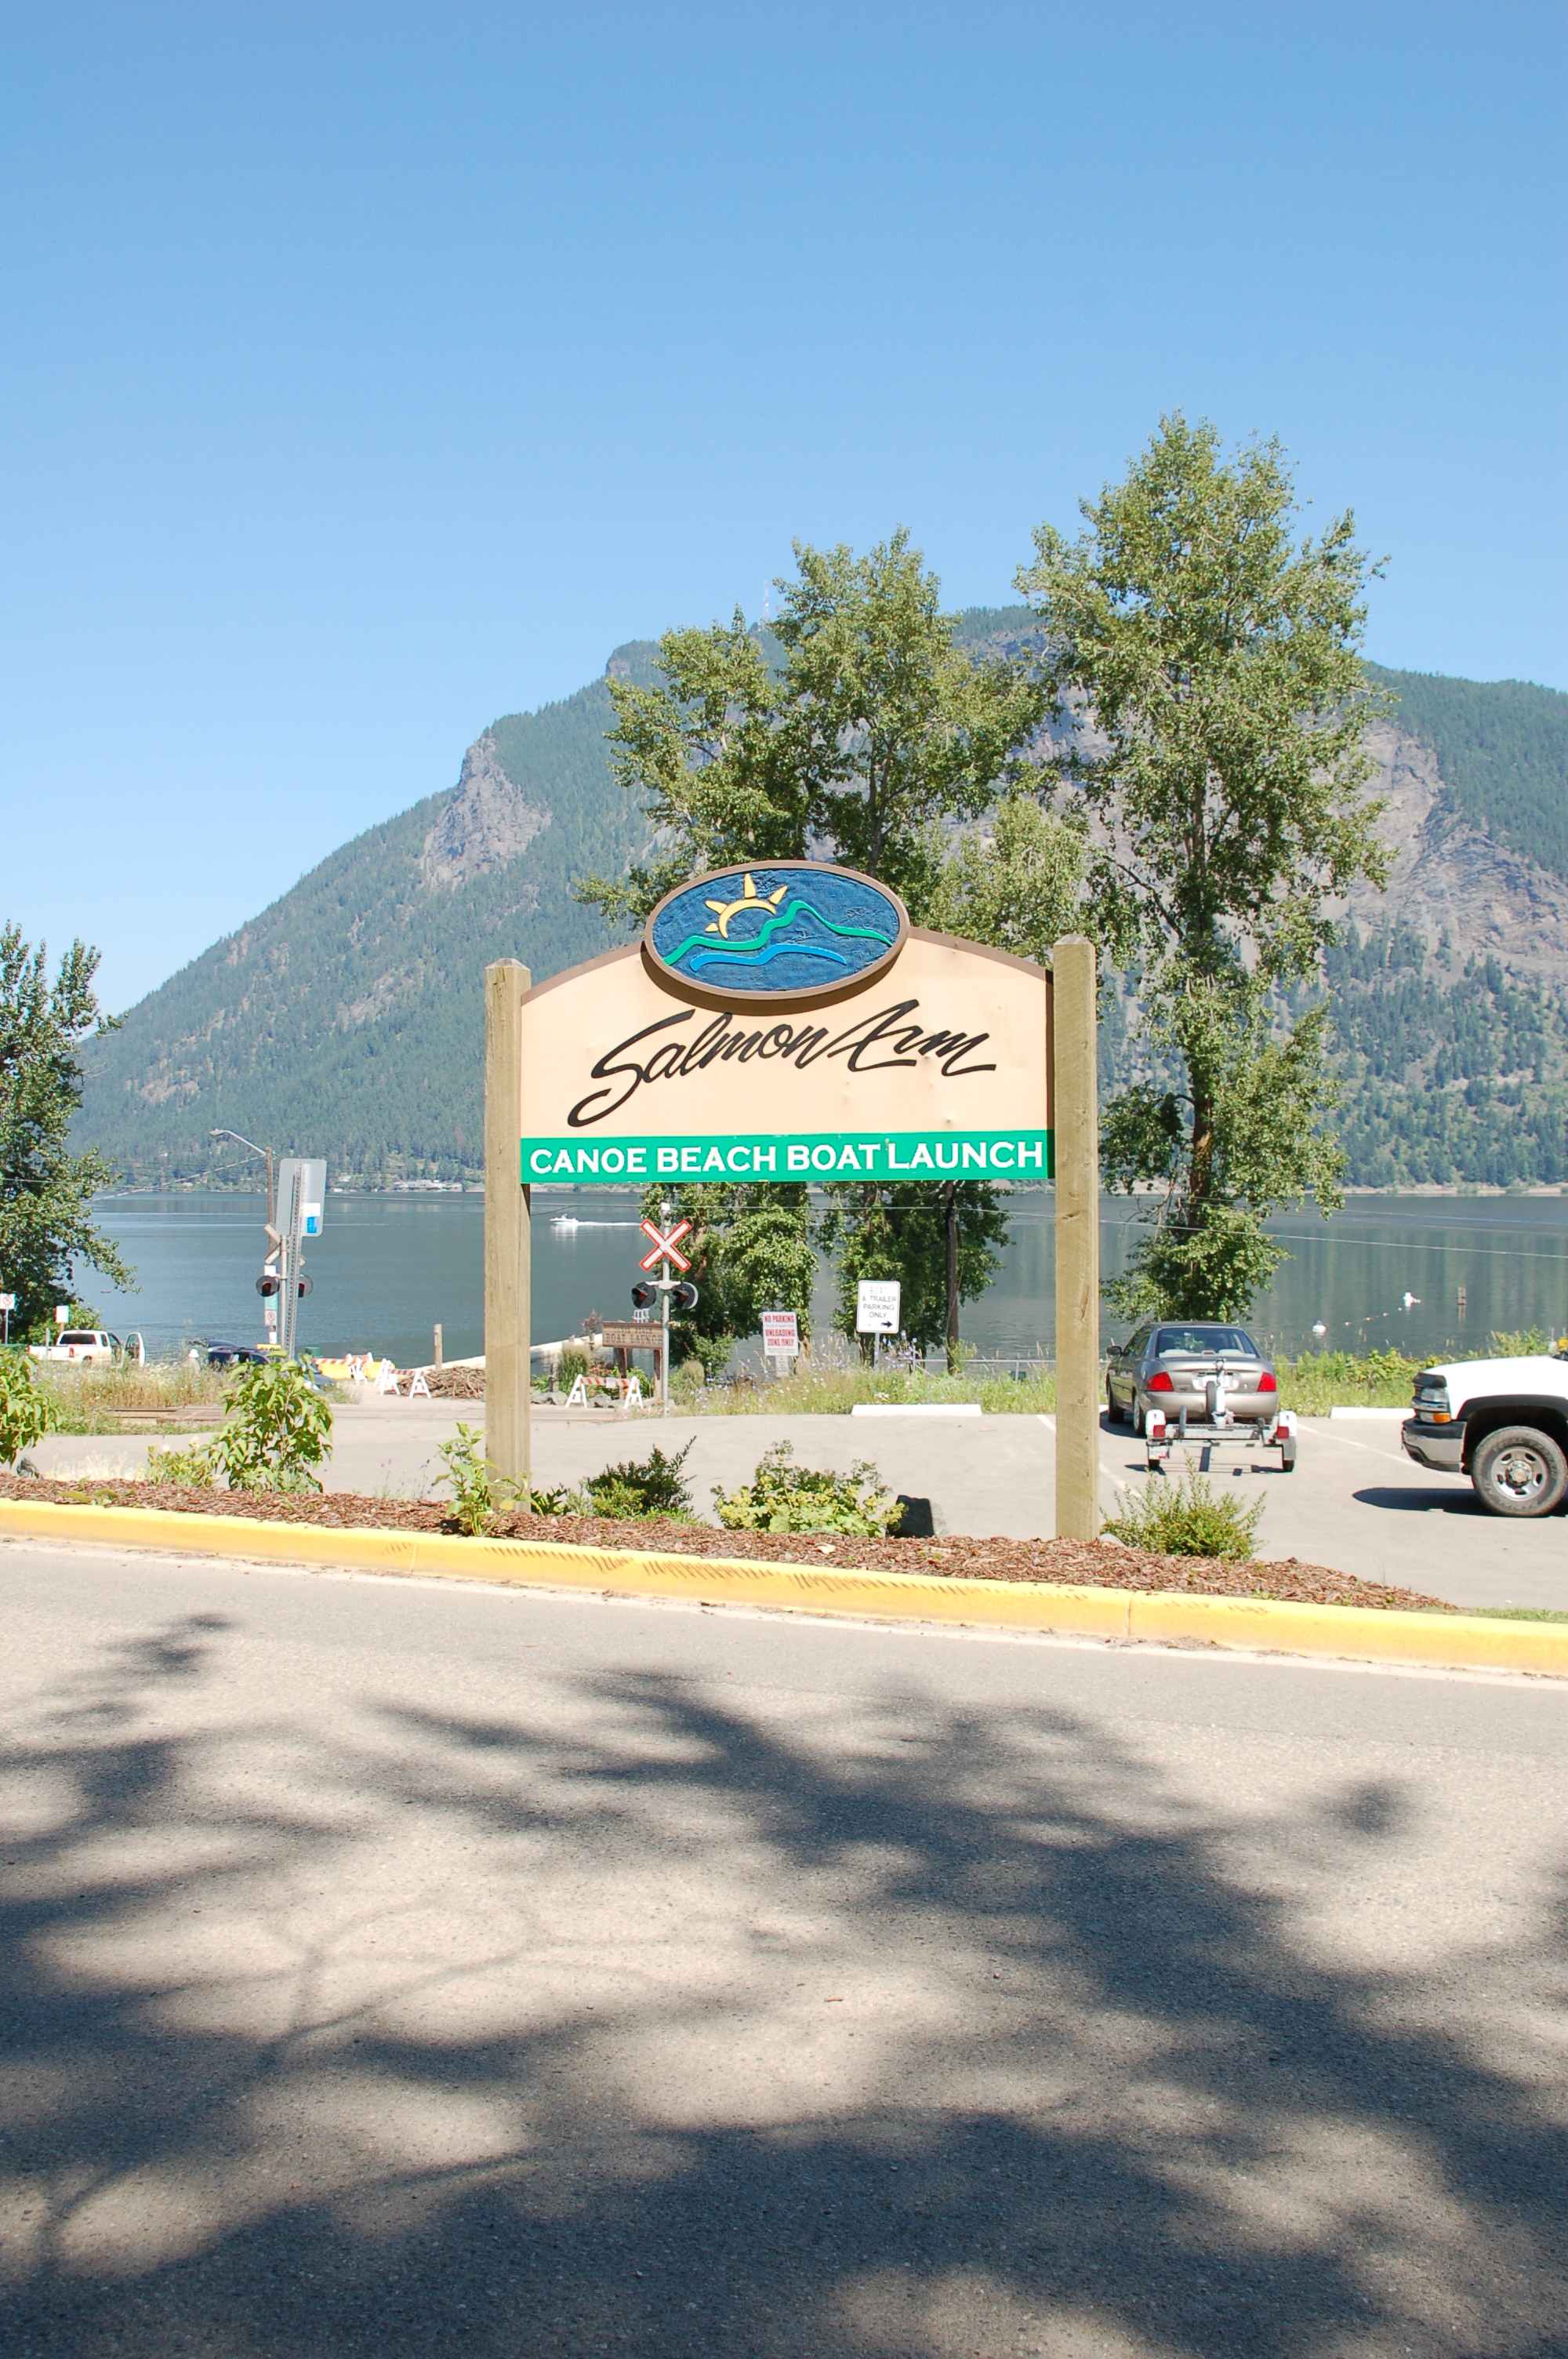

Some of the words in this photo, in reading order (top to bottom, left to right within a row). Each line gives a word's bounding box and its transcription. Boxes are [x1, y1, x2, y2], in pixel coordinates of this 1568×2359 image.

[567, 1009, 829, 1128] Salmon
[826, 999, 996, 1077] Arm
[530, 1147, 647, 1174] CANOE
[656, 1146, 777, 1173] BEACH
[787, 1143, 880, 1171] BOAT
[887, 1141, 1043, 1169] LAUNCH
[764, 1314, 771, 1323] NO
[772, 1314, 794, 1323] PARKING
[765, 1329, 795, 1337] UNLOADING
[606, 1333, 626, 1343] BOAT
[768, 1338, 780, 1347] ZONE
[781, 1338, 794, 1347] ONLY
